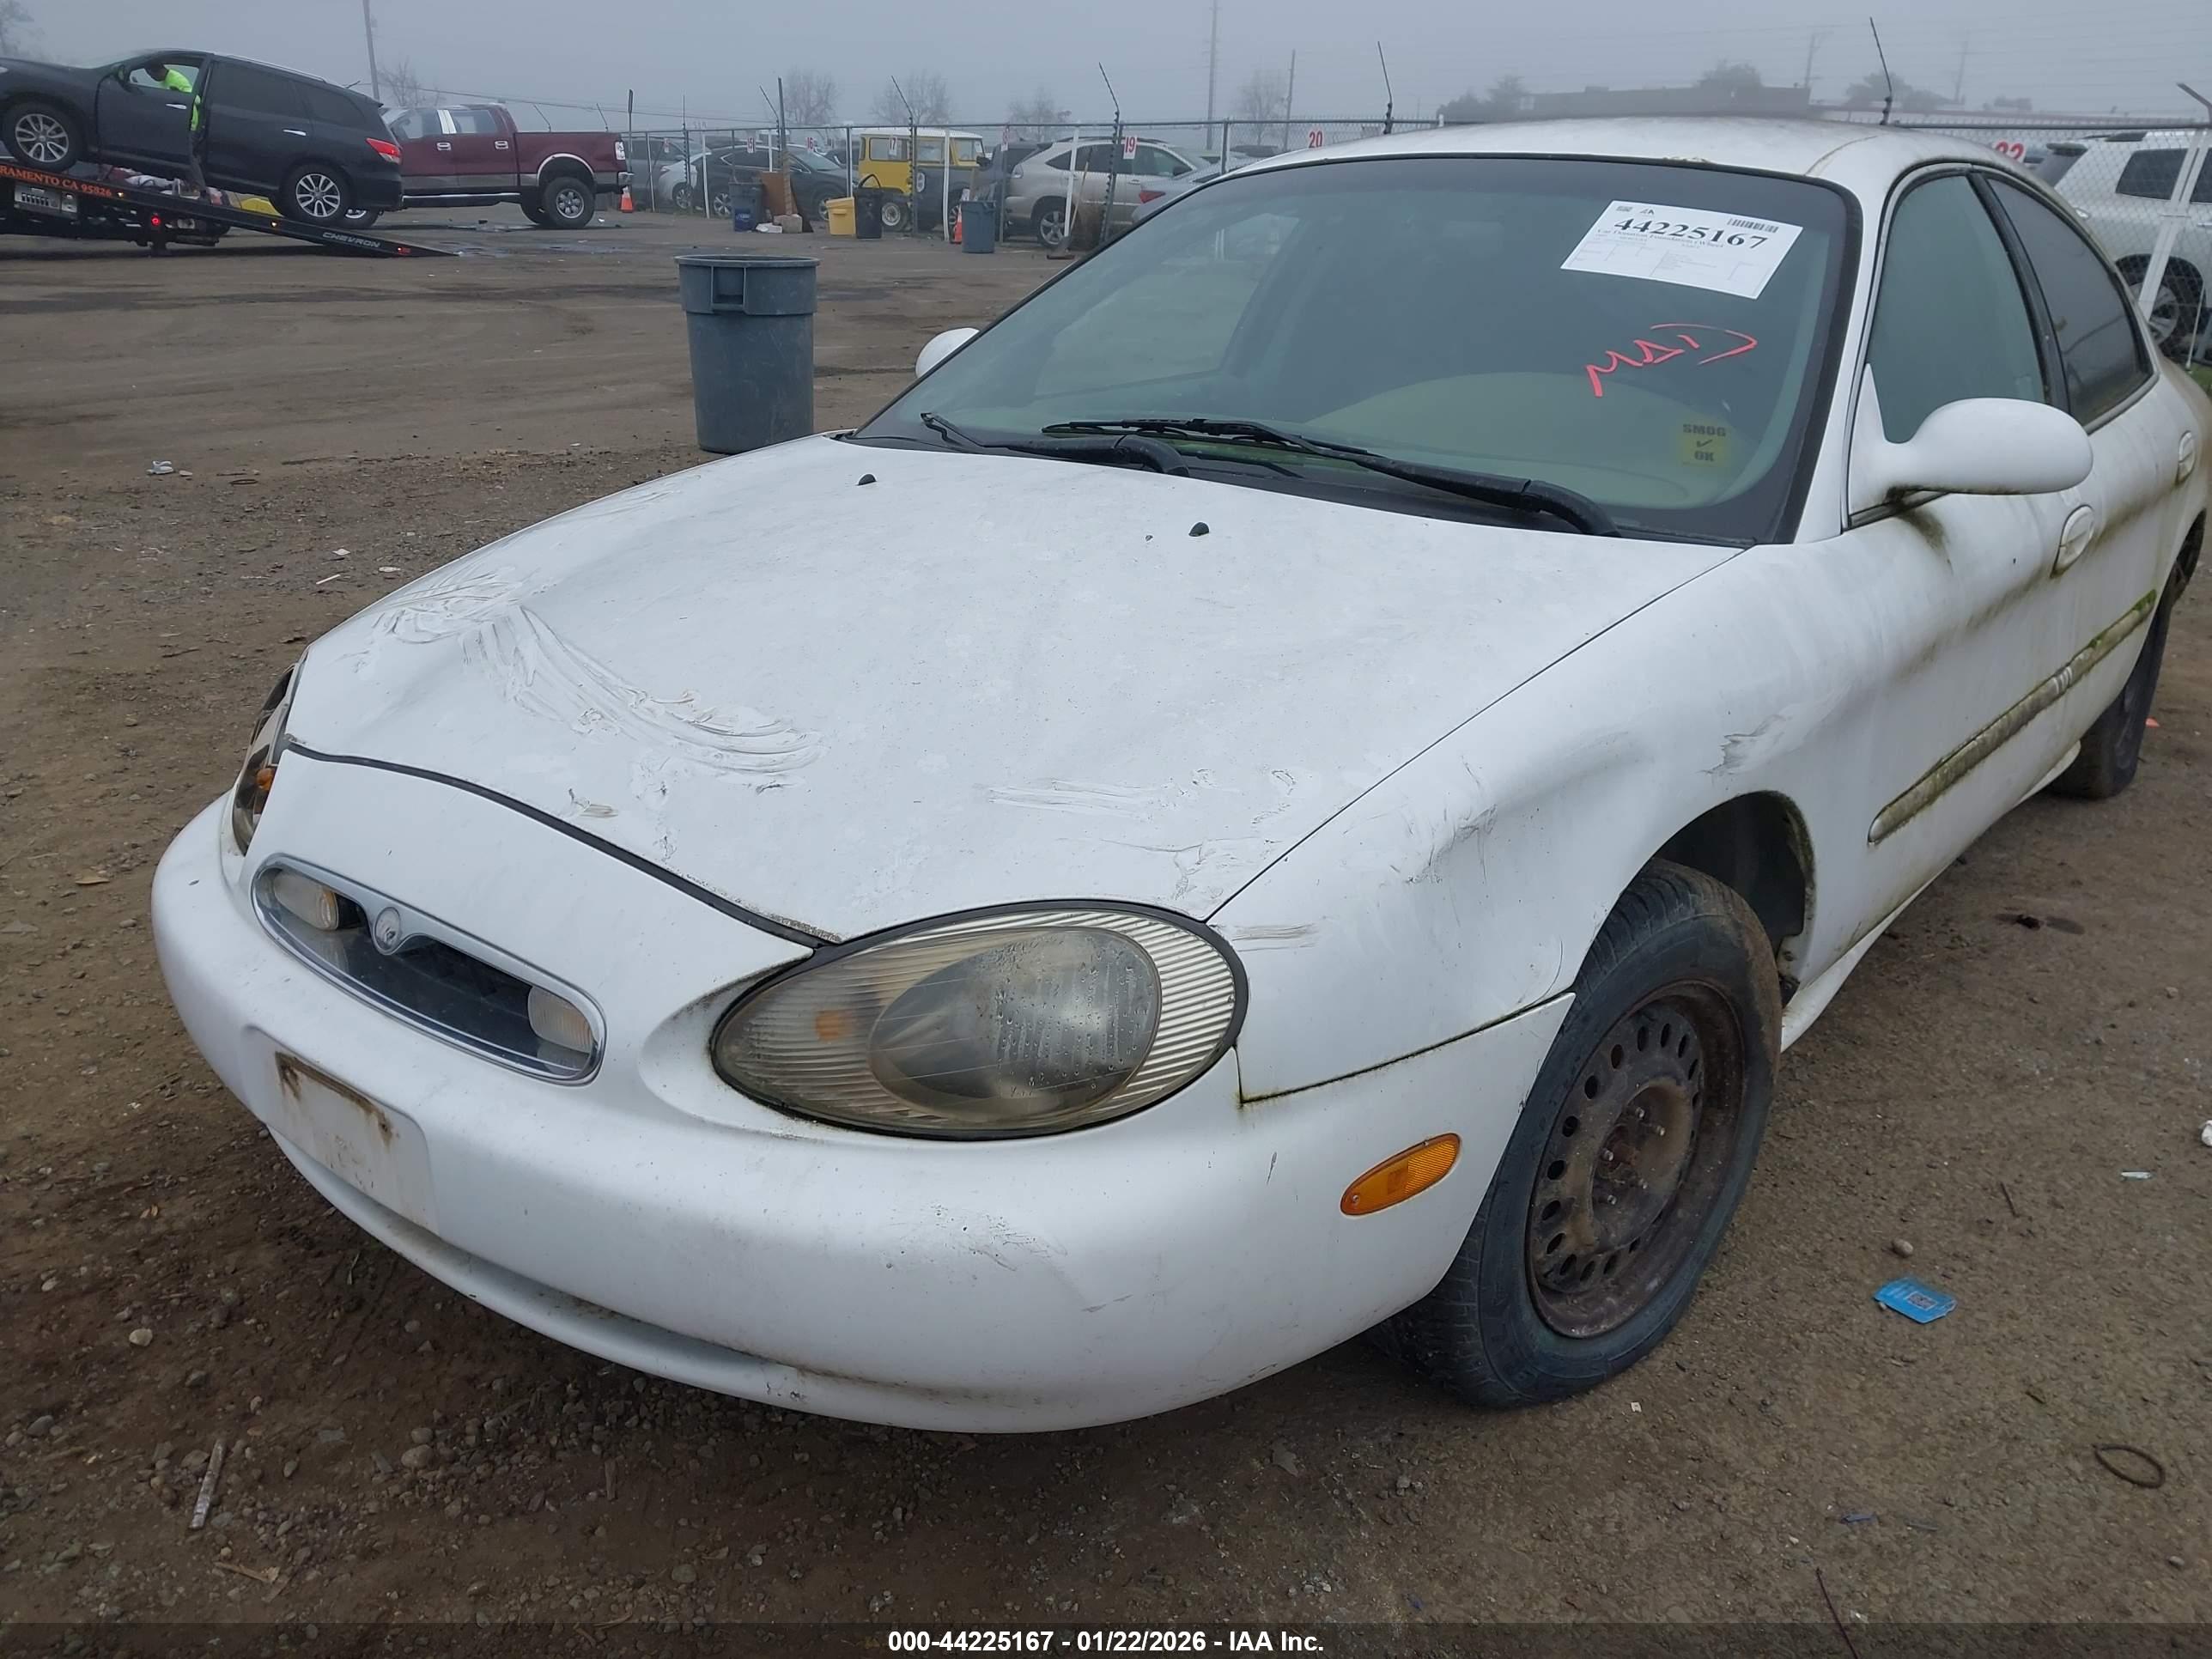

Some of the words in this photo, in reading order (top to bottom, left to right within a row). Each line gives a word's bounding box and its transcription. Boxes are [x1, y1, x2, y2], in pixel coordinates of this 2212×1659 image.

[1125, 136, 1136, 153] 19
[1308, 130, 1323, 149] 20
[61, 179, 79, 191] CA
[322, 232, 381, 248] CHEVRON
[1613, 217, 1769, 249] 44225167
[1682, 423, 1726, 437] SMOG
[1694, 450, 1715, 462] OK
